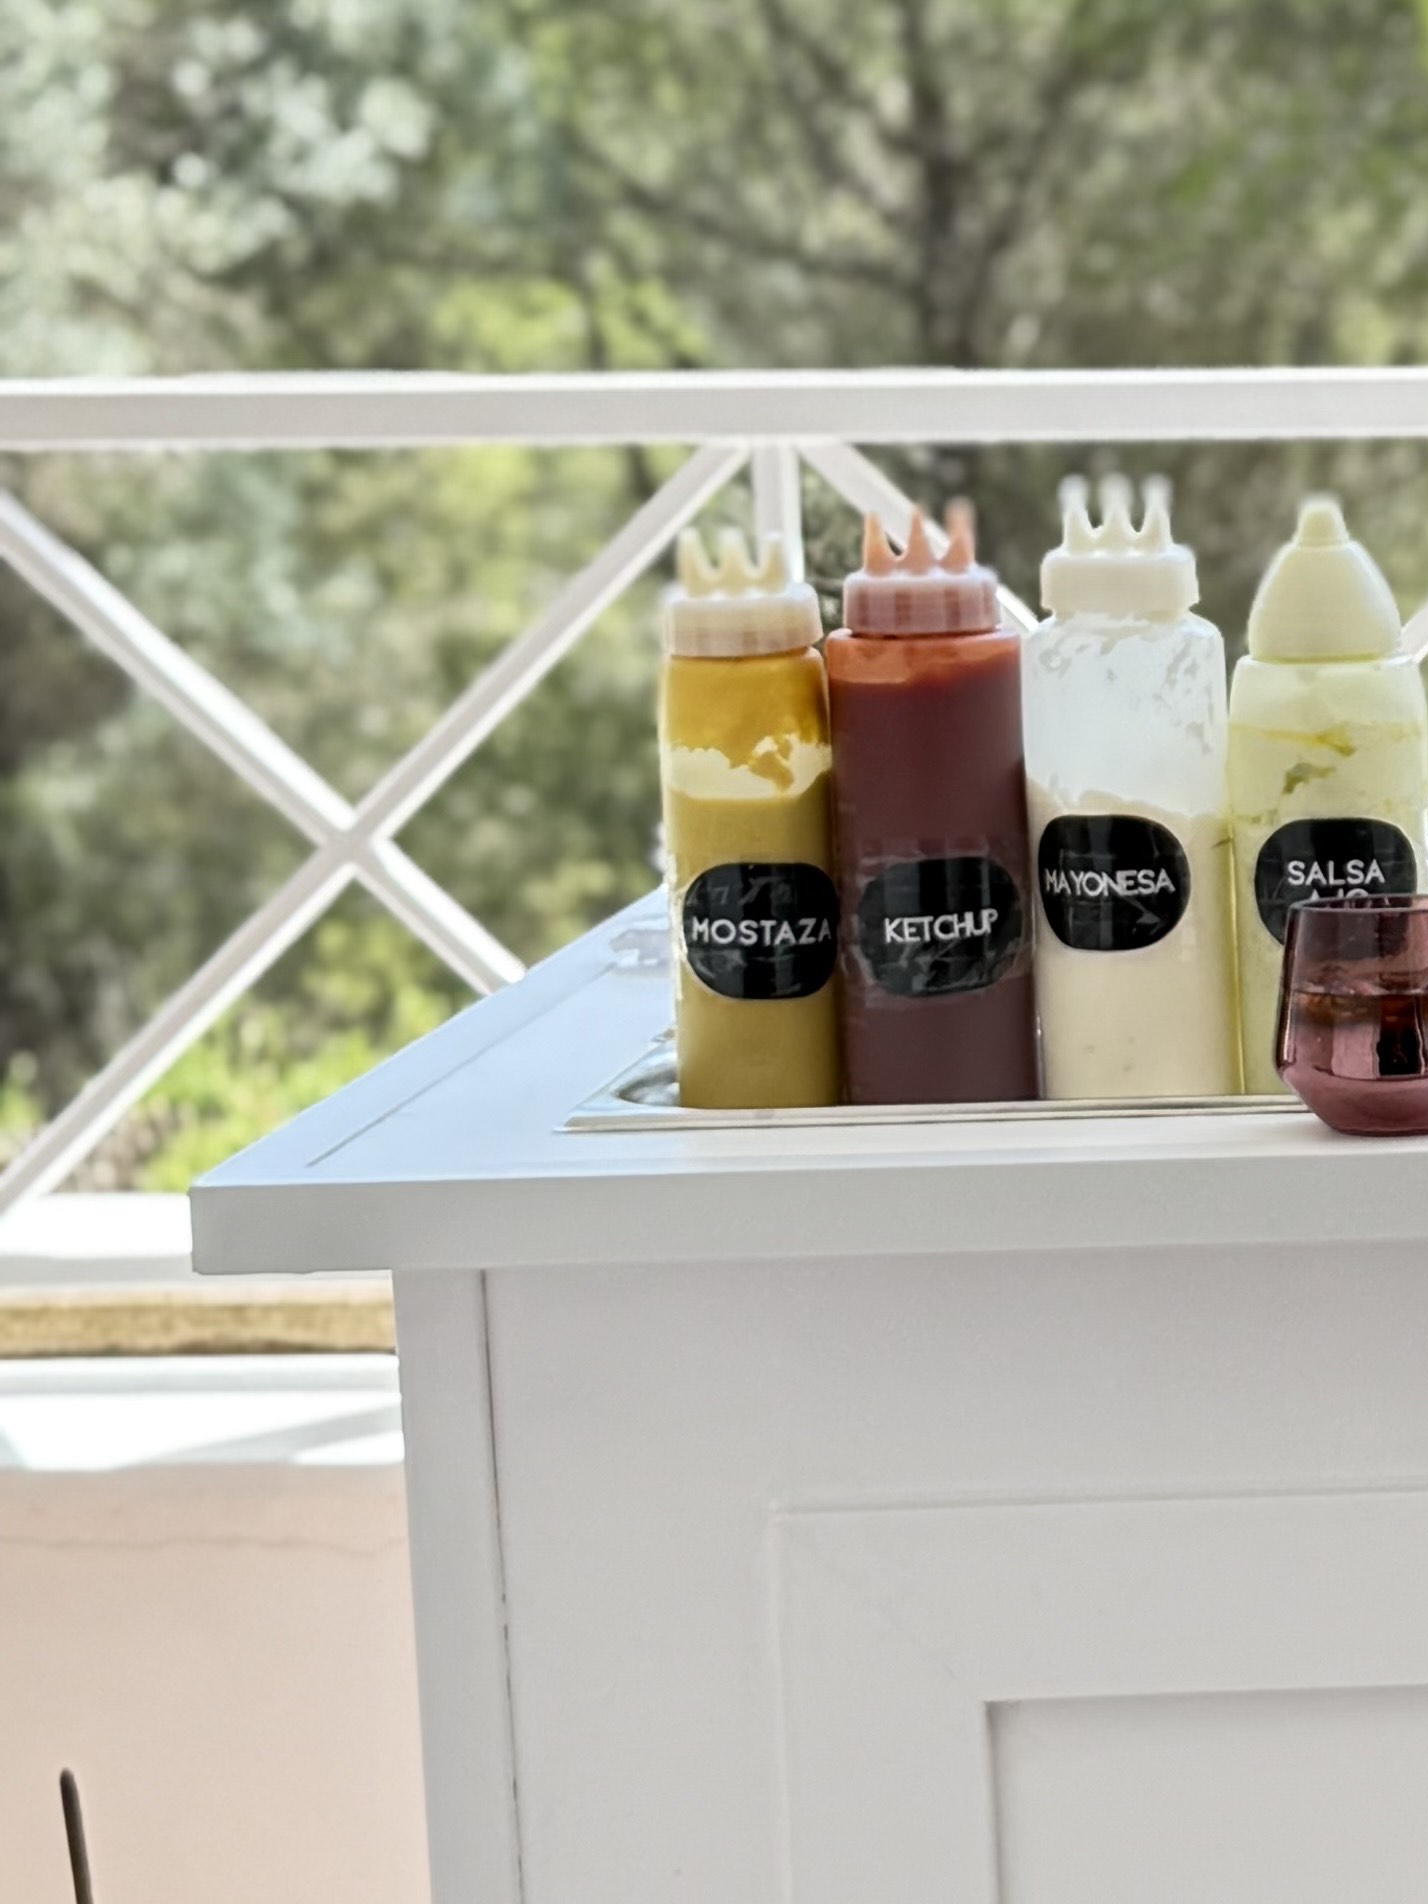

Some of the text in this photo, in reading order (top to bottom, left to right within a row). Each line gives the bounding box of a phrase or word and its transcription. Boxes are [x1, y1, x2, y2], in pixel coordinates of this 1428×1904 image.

[1044, 867, 1176, 898] MAYONESA
[1287, 858, 1387, 887] SALSA
[691, 917, 832, 946] MOSTAZA
[883, 907, 999, 944] KETCHUP
